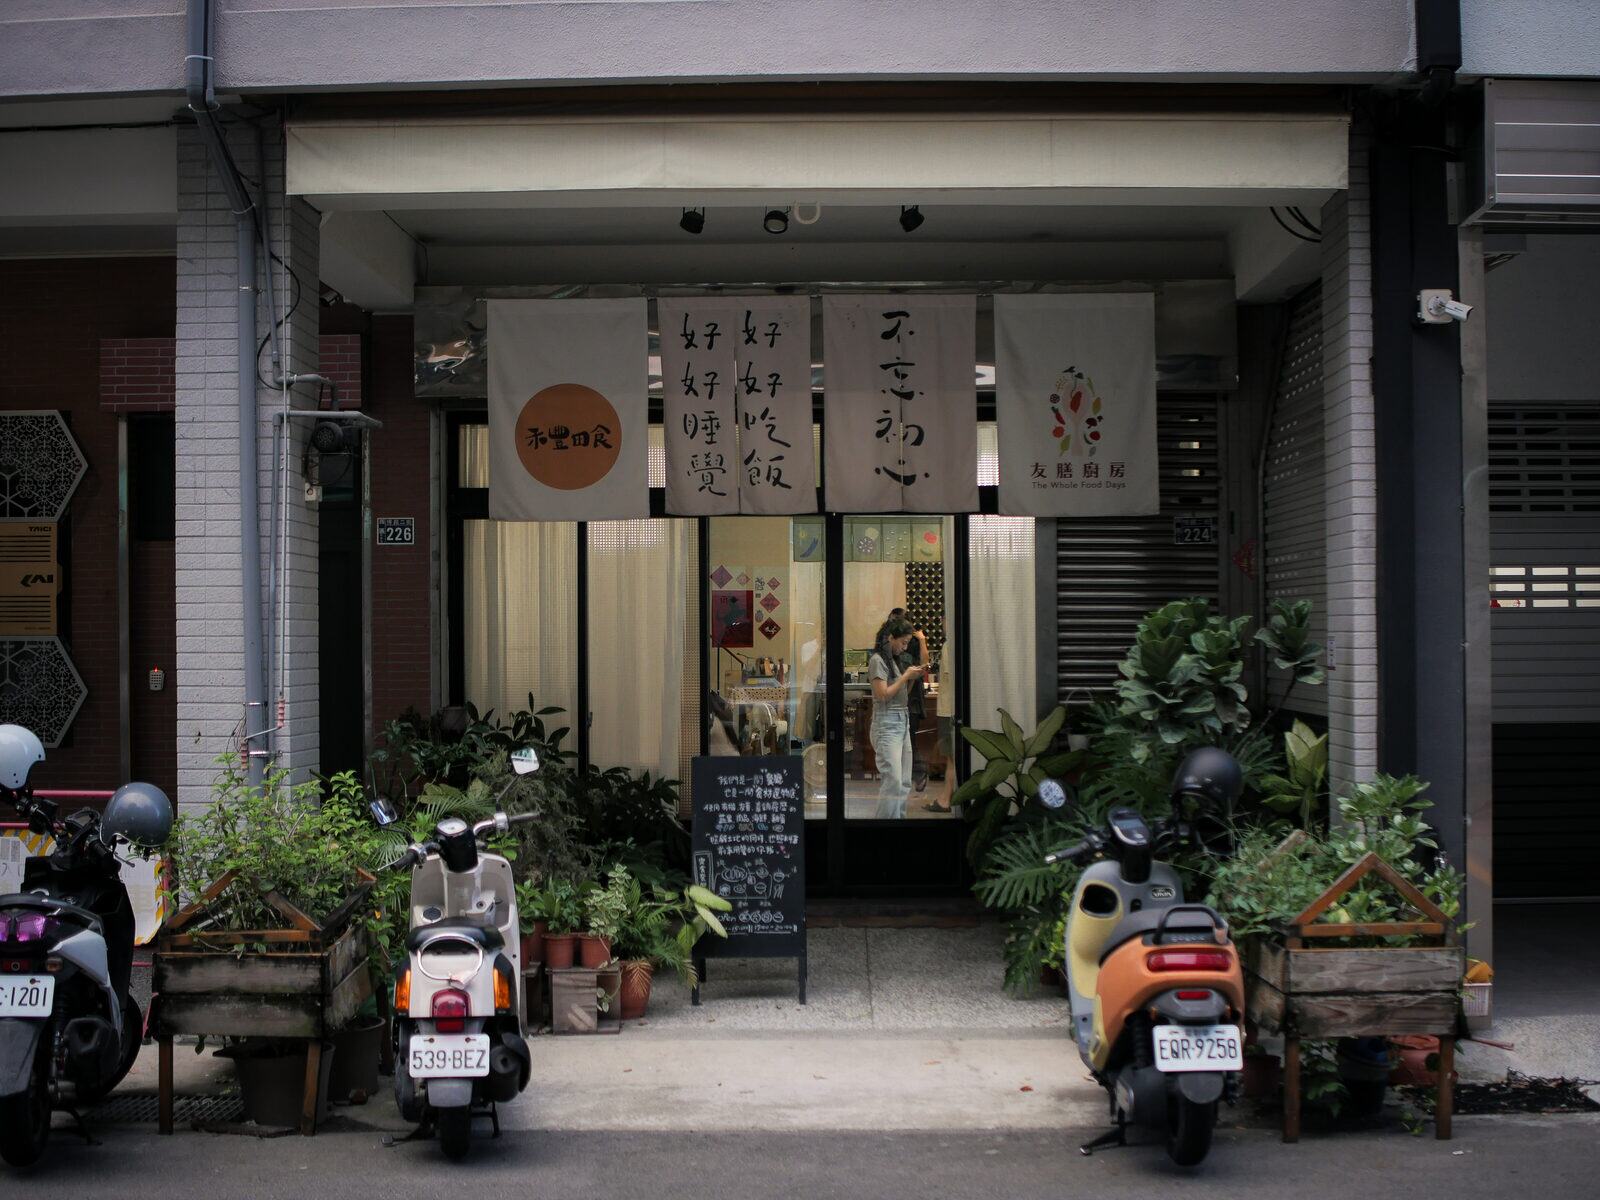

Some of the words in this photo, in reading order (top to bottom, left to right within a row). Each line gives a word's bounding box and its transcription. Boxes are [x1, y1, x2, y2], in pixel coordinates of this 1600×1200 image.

[680, 312, 727, 496] 好好睡覺
[739, 310, 792, 489] 好好吃飯
[874, 310, 930, 486] 不忘初心
[1030, 461, 1125, 479] 友膳廚房
[1032, 481, 1048, 489] The
[1050, 481, 1078, 489] Whole
[1081, 481, 1102, 489] Food
[1106, 481, 1126, 490] Days
[386, 527, 411, 541] 226
[1184, 528, 1210, 542] 224
